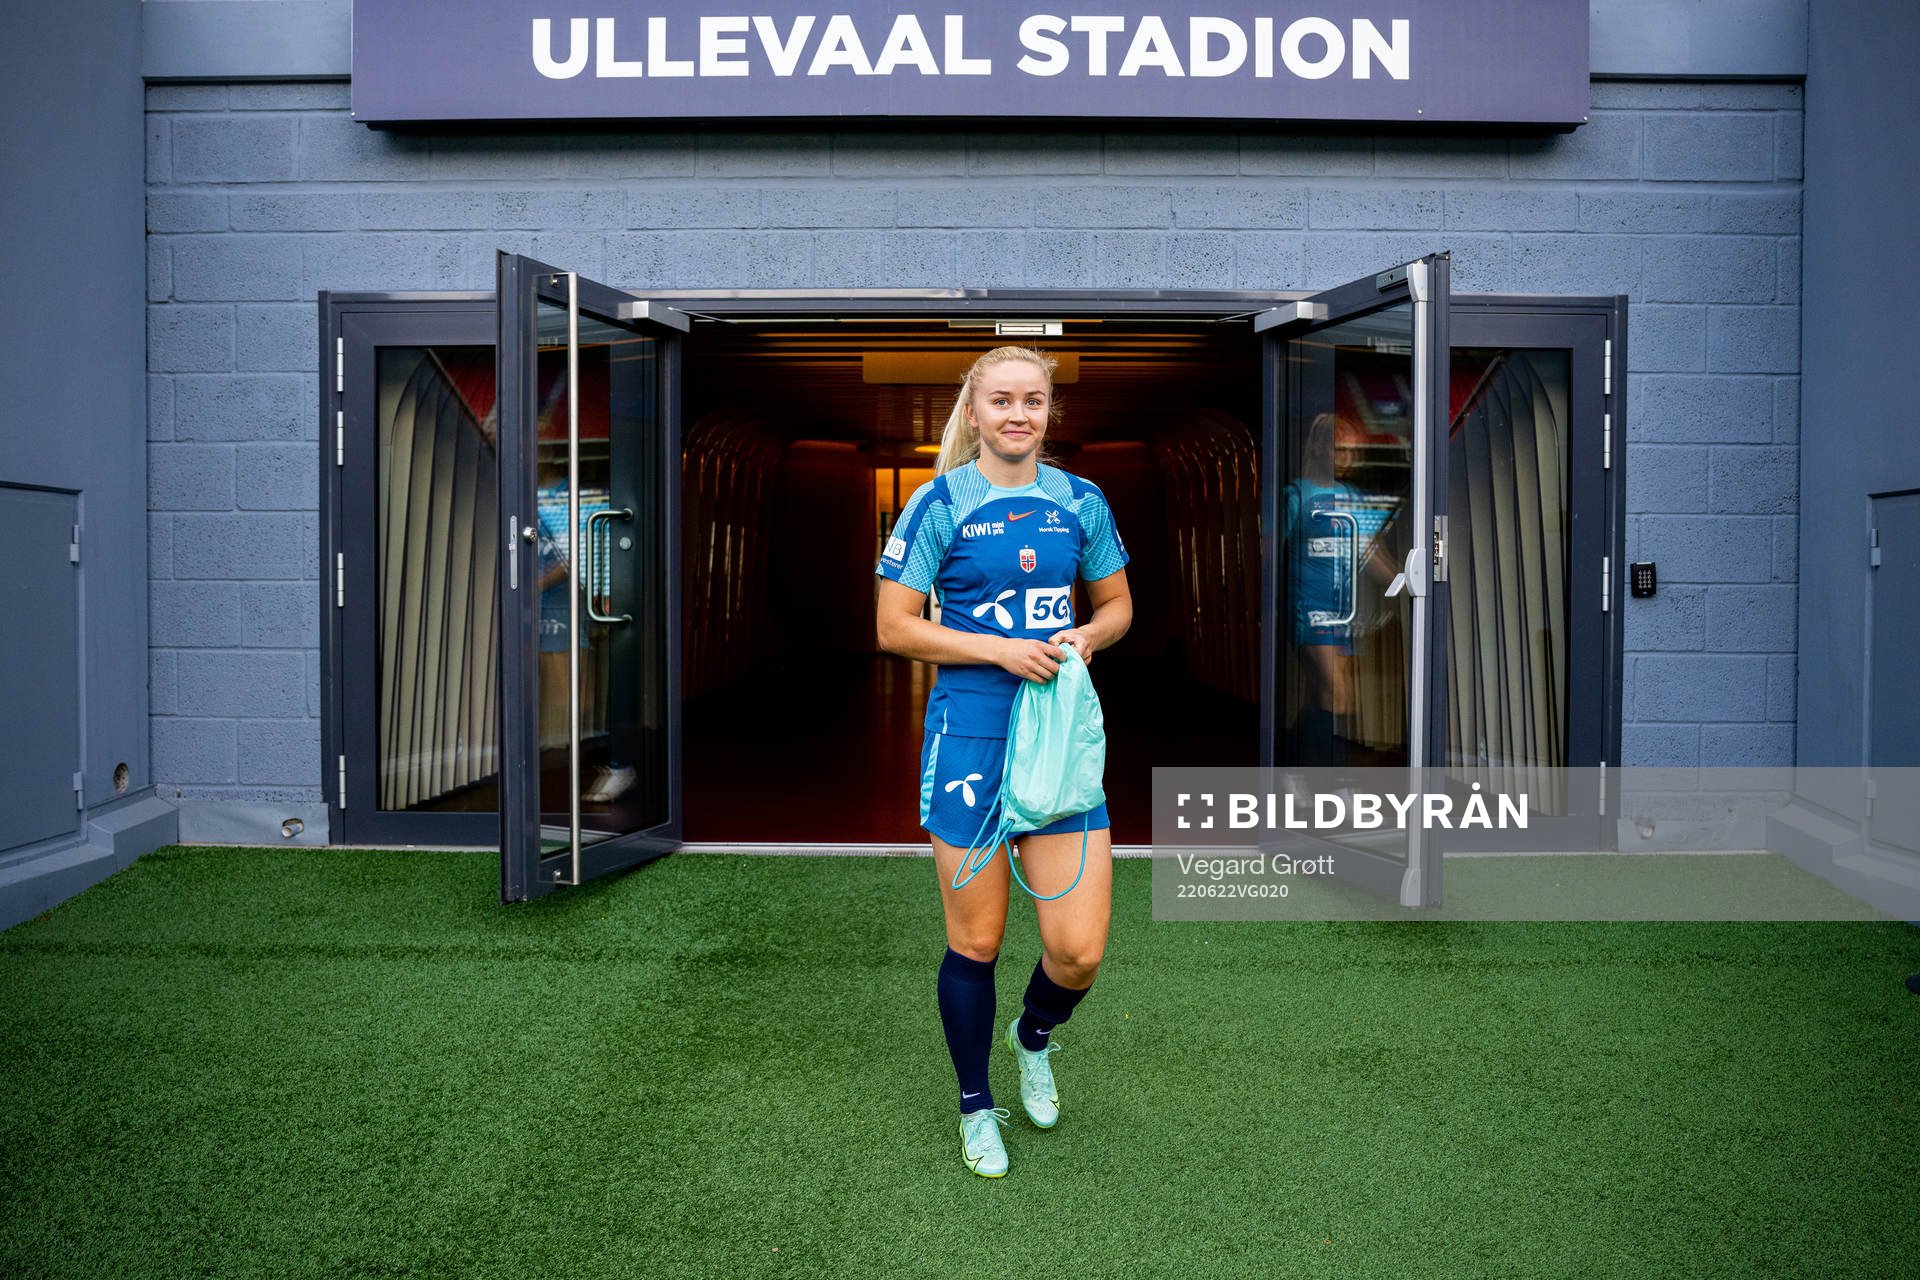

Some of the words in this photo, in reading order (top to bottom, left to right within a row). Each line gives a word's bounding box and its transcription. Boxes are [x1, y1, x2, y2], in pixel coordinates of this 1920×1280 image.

[532, 14, 992, 80] ULLEVAAL
[1016, 14, 1410, 81] STADION
[962, 522, 991, 538] KIWI
[992, 521, 1004, 529] mini
[993, 528, 1004, 536] pris
[1032, 594, 1068, 621] 5G
